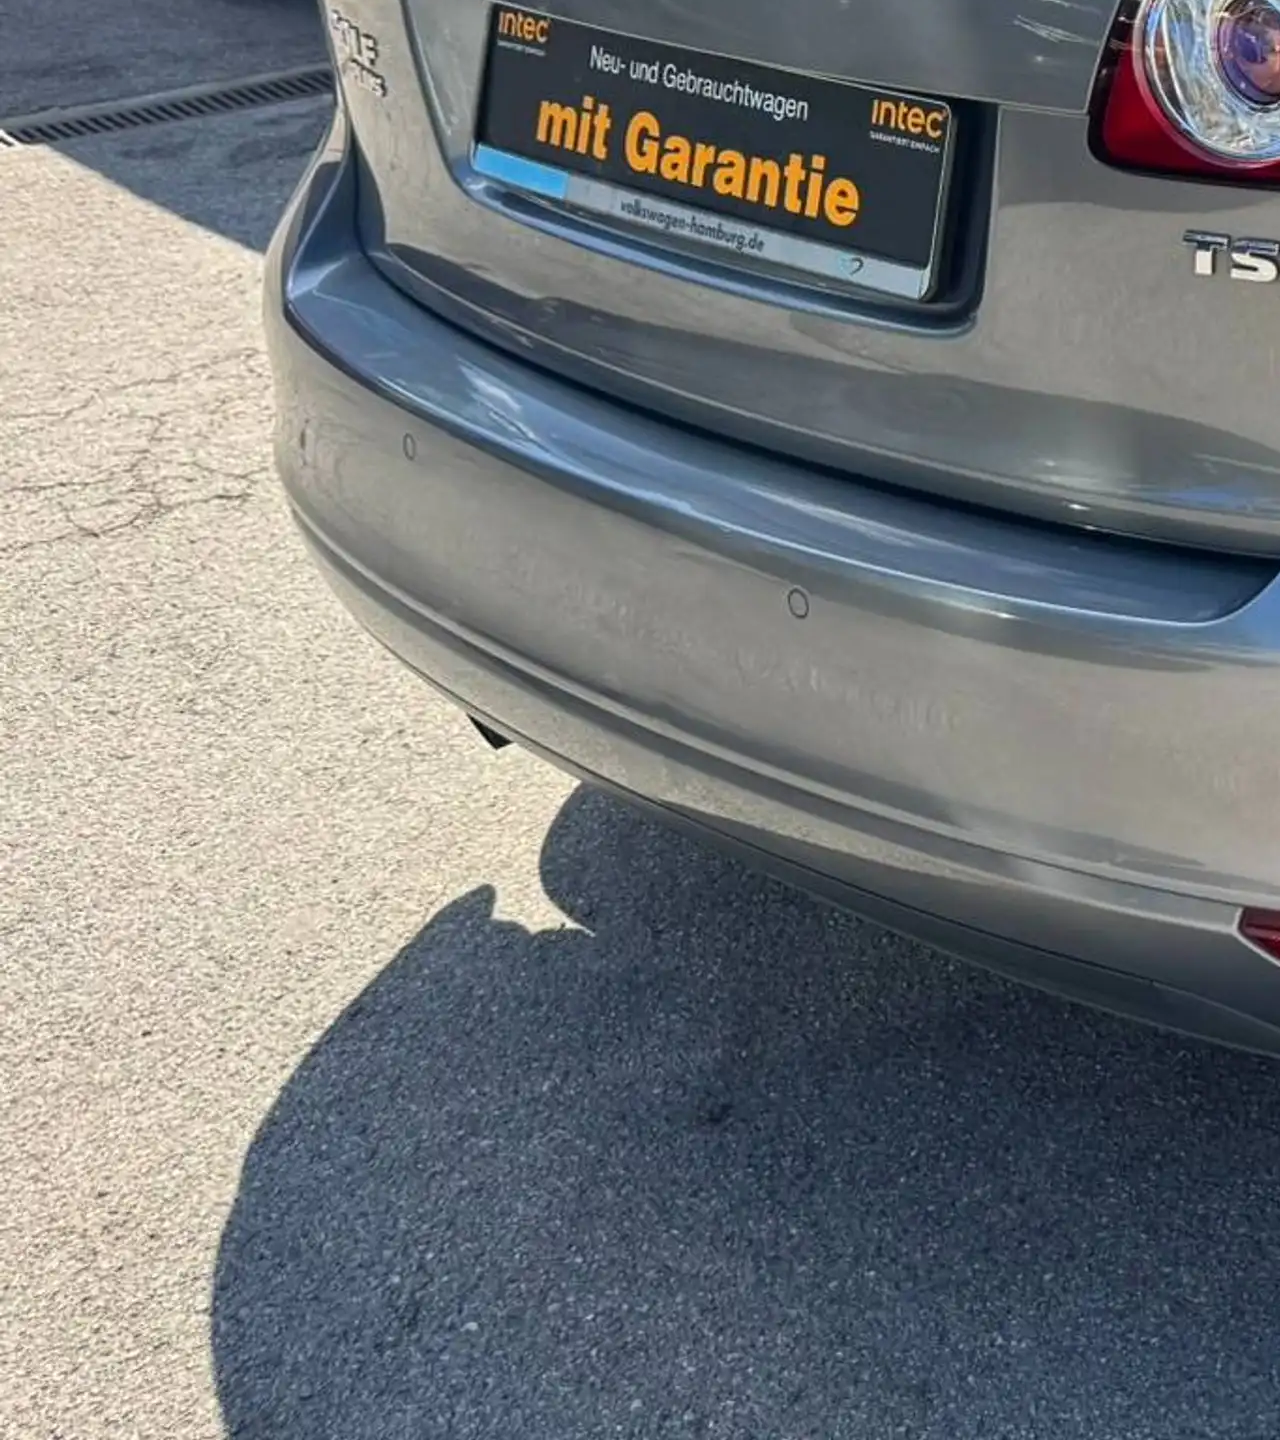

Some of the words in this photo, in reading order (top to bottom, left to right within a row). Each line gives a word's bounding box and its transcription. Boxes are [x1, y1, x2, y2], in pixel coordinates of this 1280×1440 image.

[498, 11, 550, 44] intec
[589, 44, 627, 75] Neu-
[629, 60, 660, 84] und
[662, 63, 809, 122] Gebrauchtwagen
[871, 99, 944, 138] intec
[535, 95, 612, 160] mit
[624, 110, 861, 227] Garantie
[620, 198, 766, 253] volkswagen-hamburg.de
